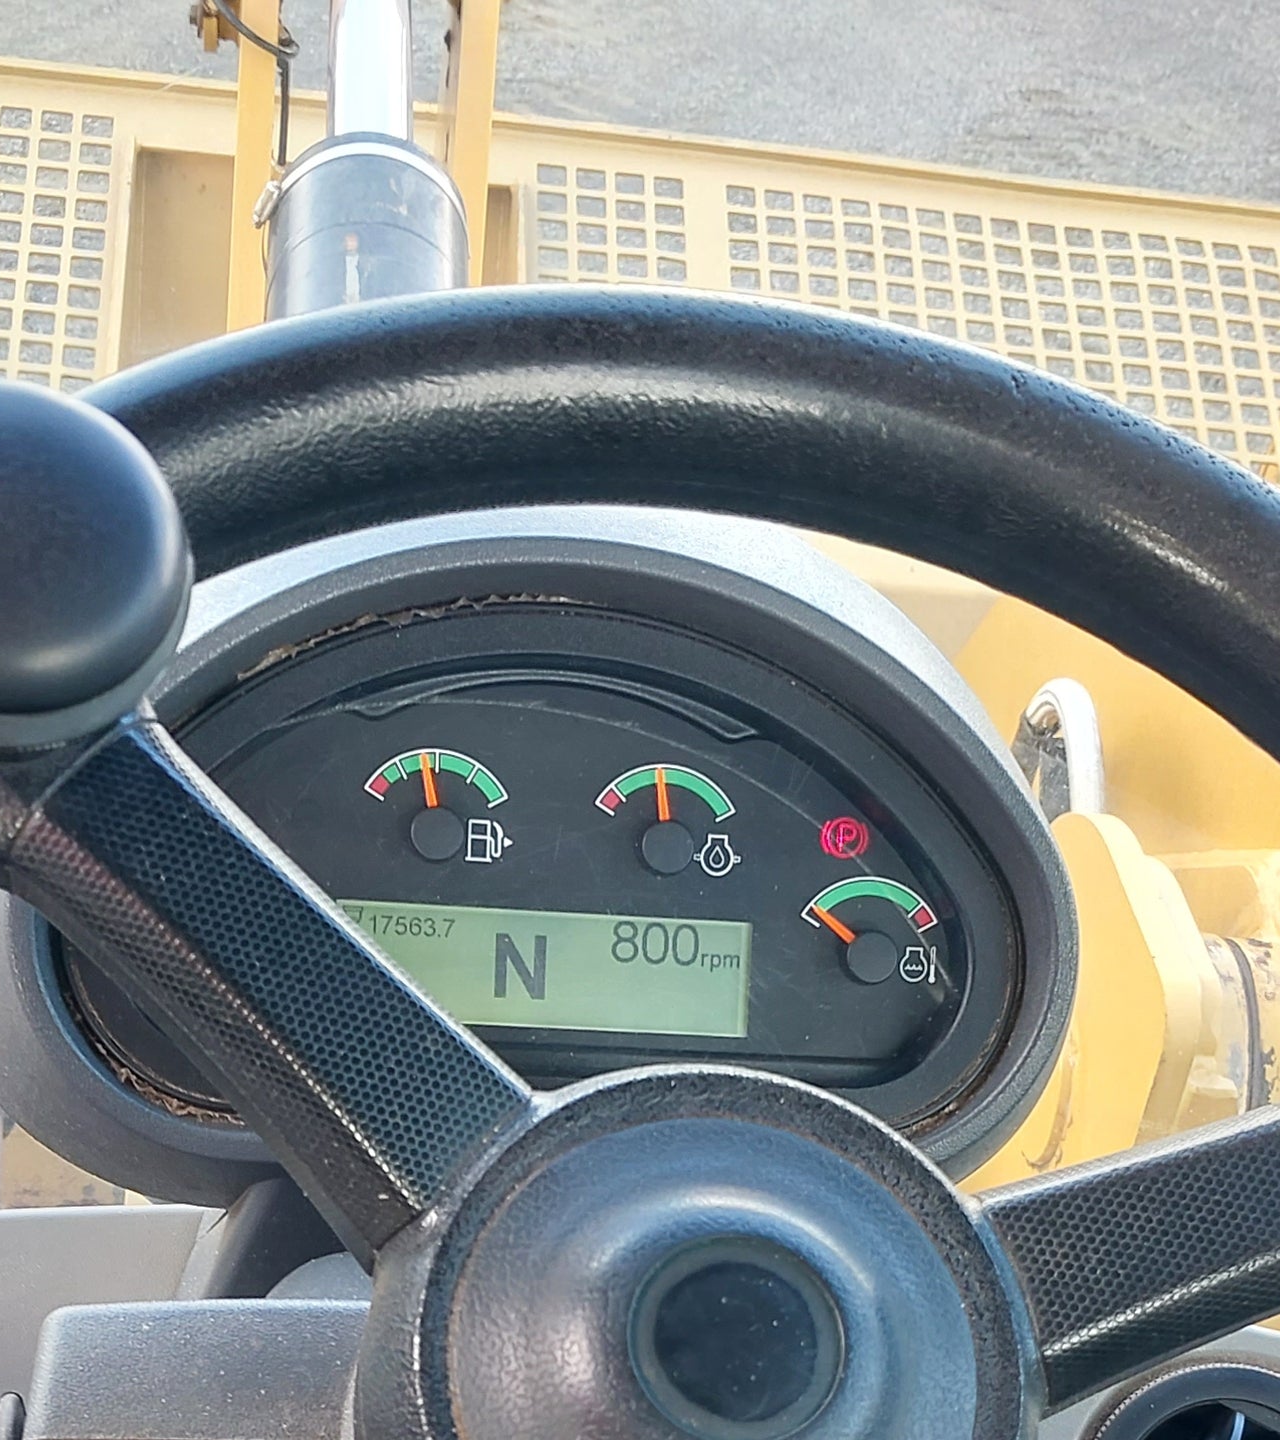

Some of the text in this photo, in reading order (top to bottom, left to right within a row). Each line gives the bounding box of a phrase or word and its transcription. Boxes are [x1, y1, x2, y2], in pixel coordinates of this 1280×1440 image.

[369, 914, 456, 938] 17563.7
[611, 920, 740, 972] 800 rpm
[494, 932, 547, 1000] N
